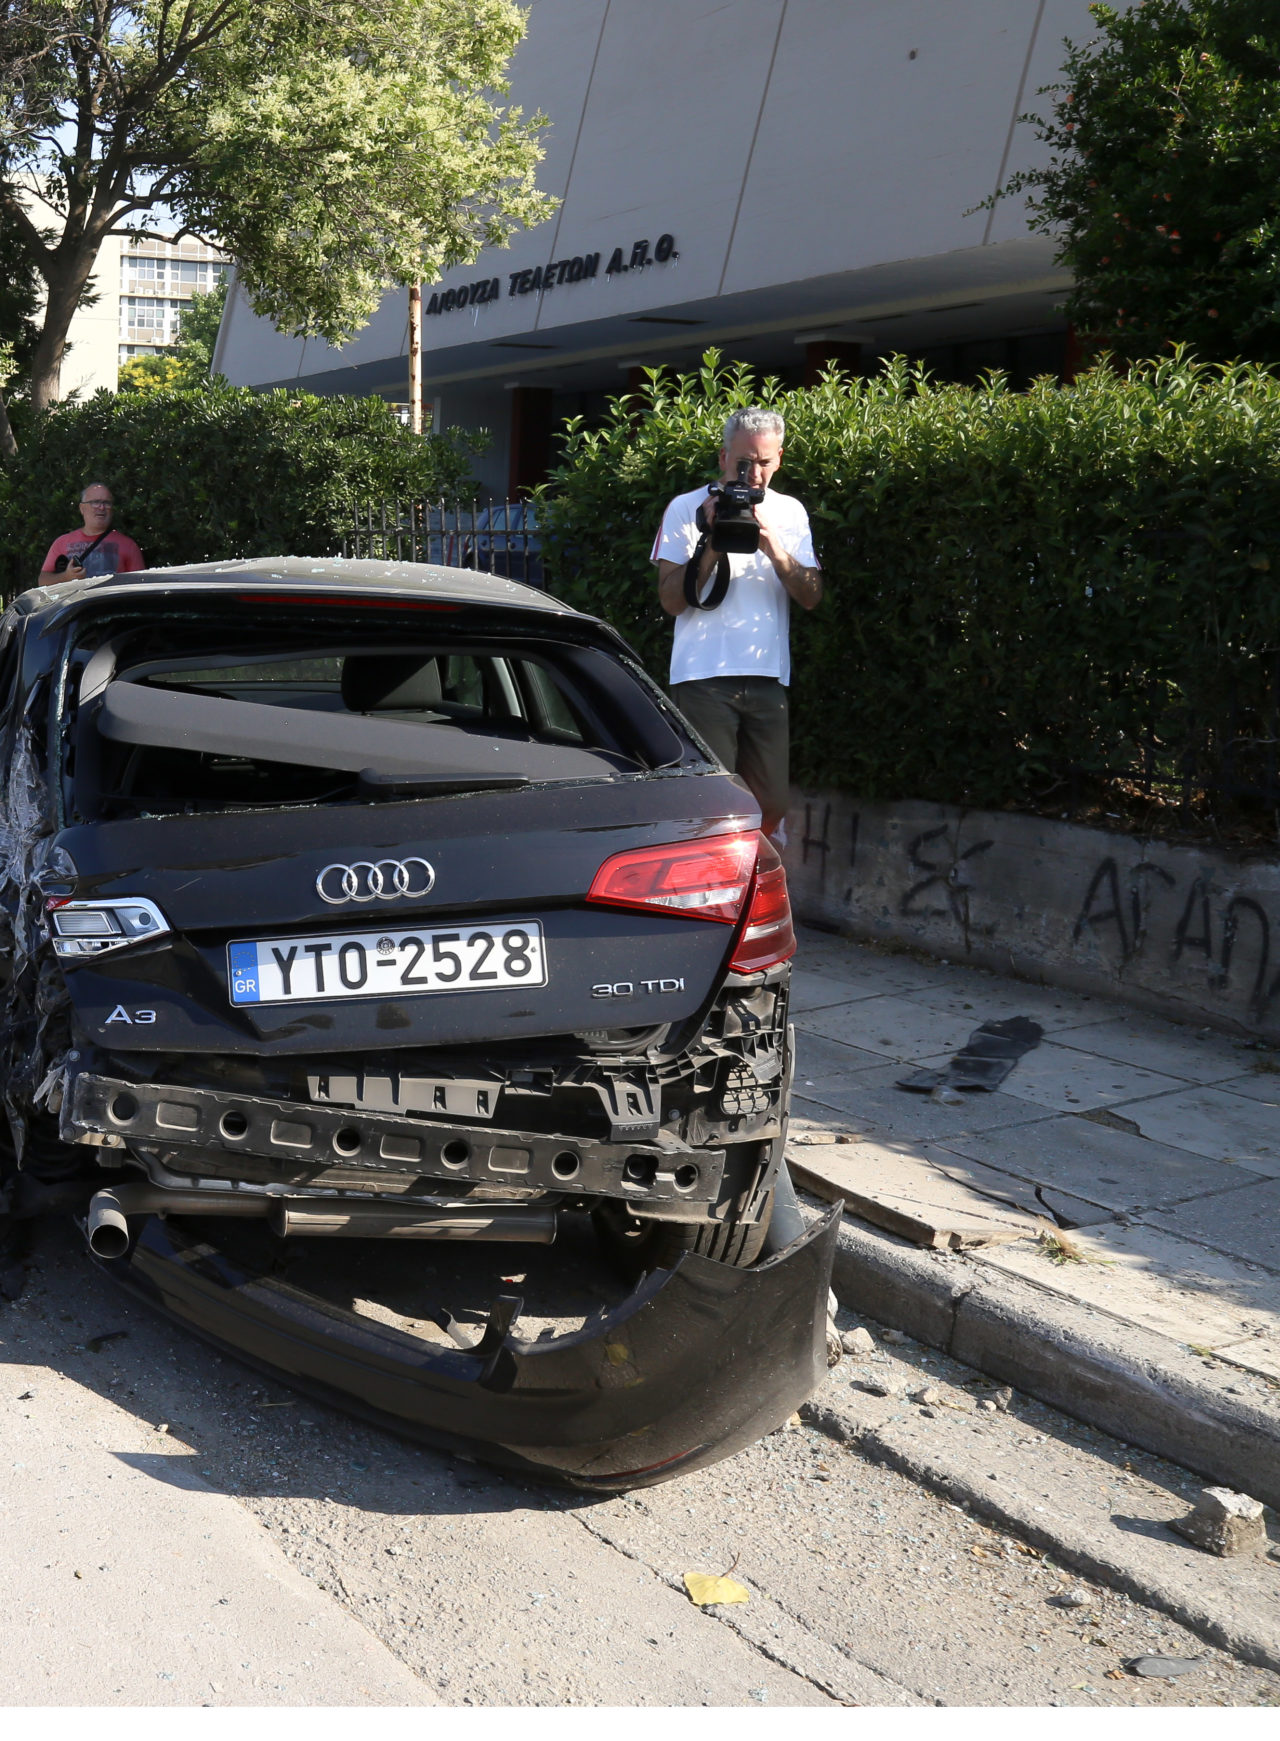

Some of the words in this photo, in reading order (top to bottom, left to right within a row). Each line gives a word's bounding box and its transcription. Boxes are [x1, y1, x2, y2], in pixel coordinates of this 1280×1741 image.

[425, 277, 500, 316] ΑΙΘΟΥΣΑ
[508, 252, 601, 297] ΤΕΛΕΤΩΝ
[1073, 856, 1280, 1025] ΑΓΑΠ
[233, 978, 257, 995] GR
[591, 981, 635, 1000] 30
[639, 976, 686, 996] TDI
[104, 1004, 157, 1025] A3
